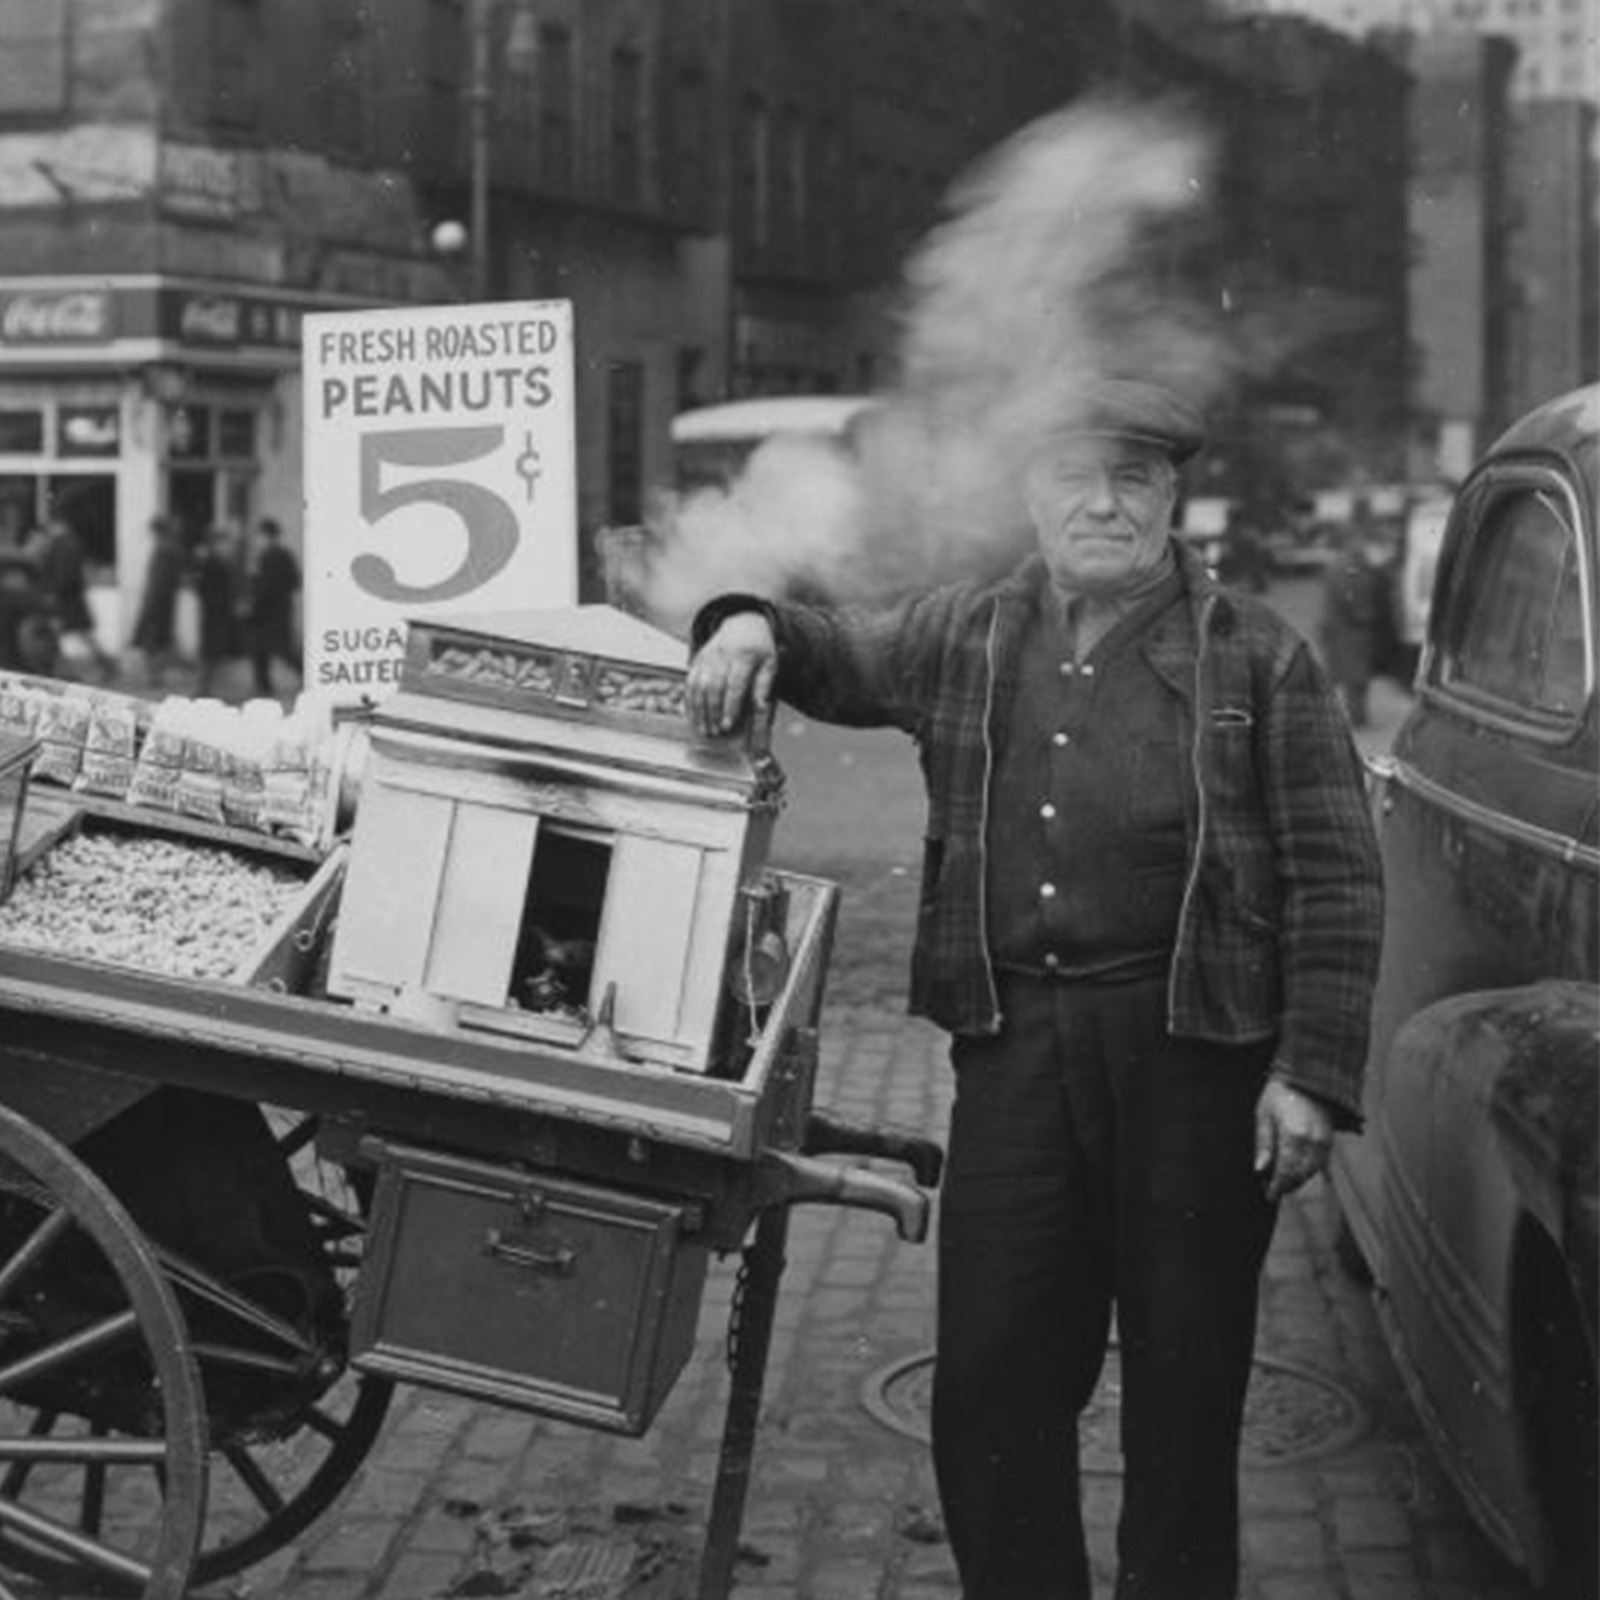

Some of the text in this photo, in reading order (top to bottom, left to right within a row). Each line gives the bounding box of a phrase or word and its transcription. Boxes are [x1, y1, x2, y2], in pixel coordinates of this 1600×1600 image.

[320, 320, 557, 365] FRESH ROASTED
[322, 366, 552, 419] PEANUTS
[323, 627, 405, 652] SUGA
